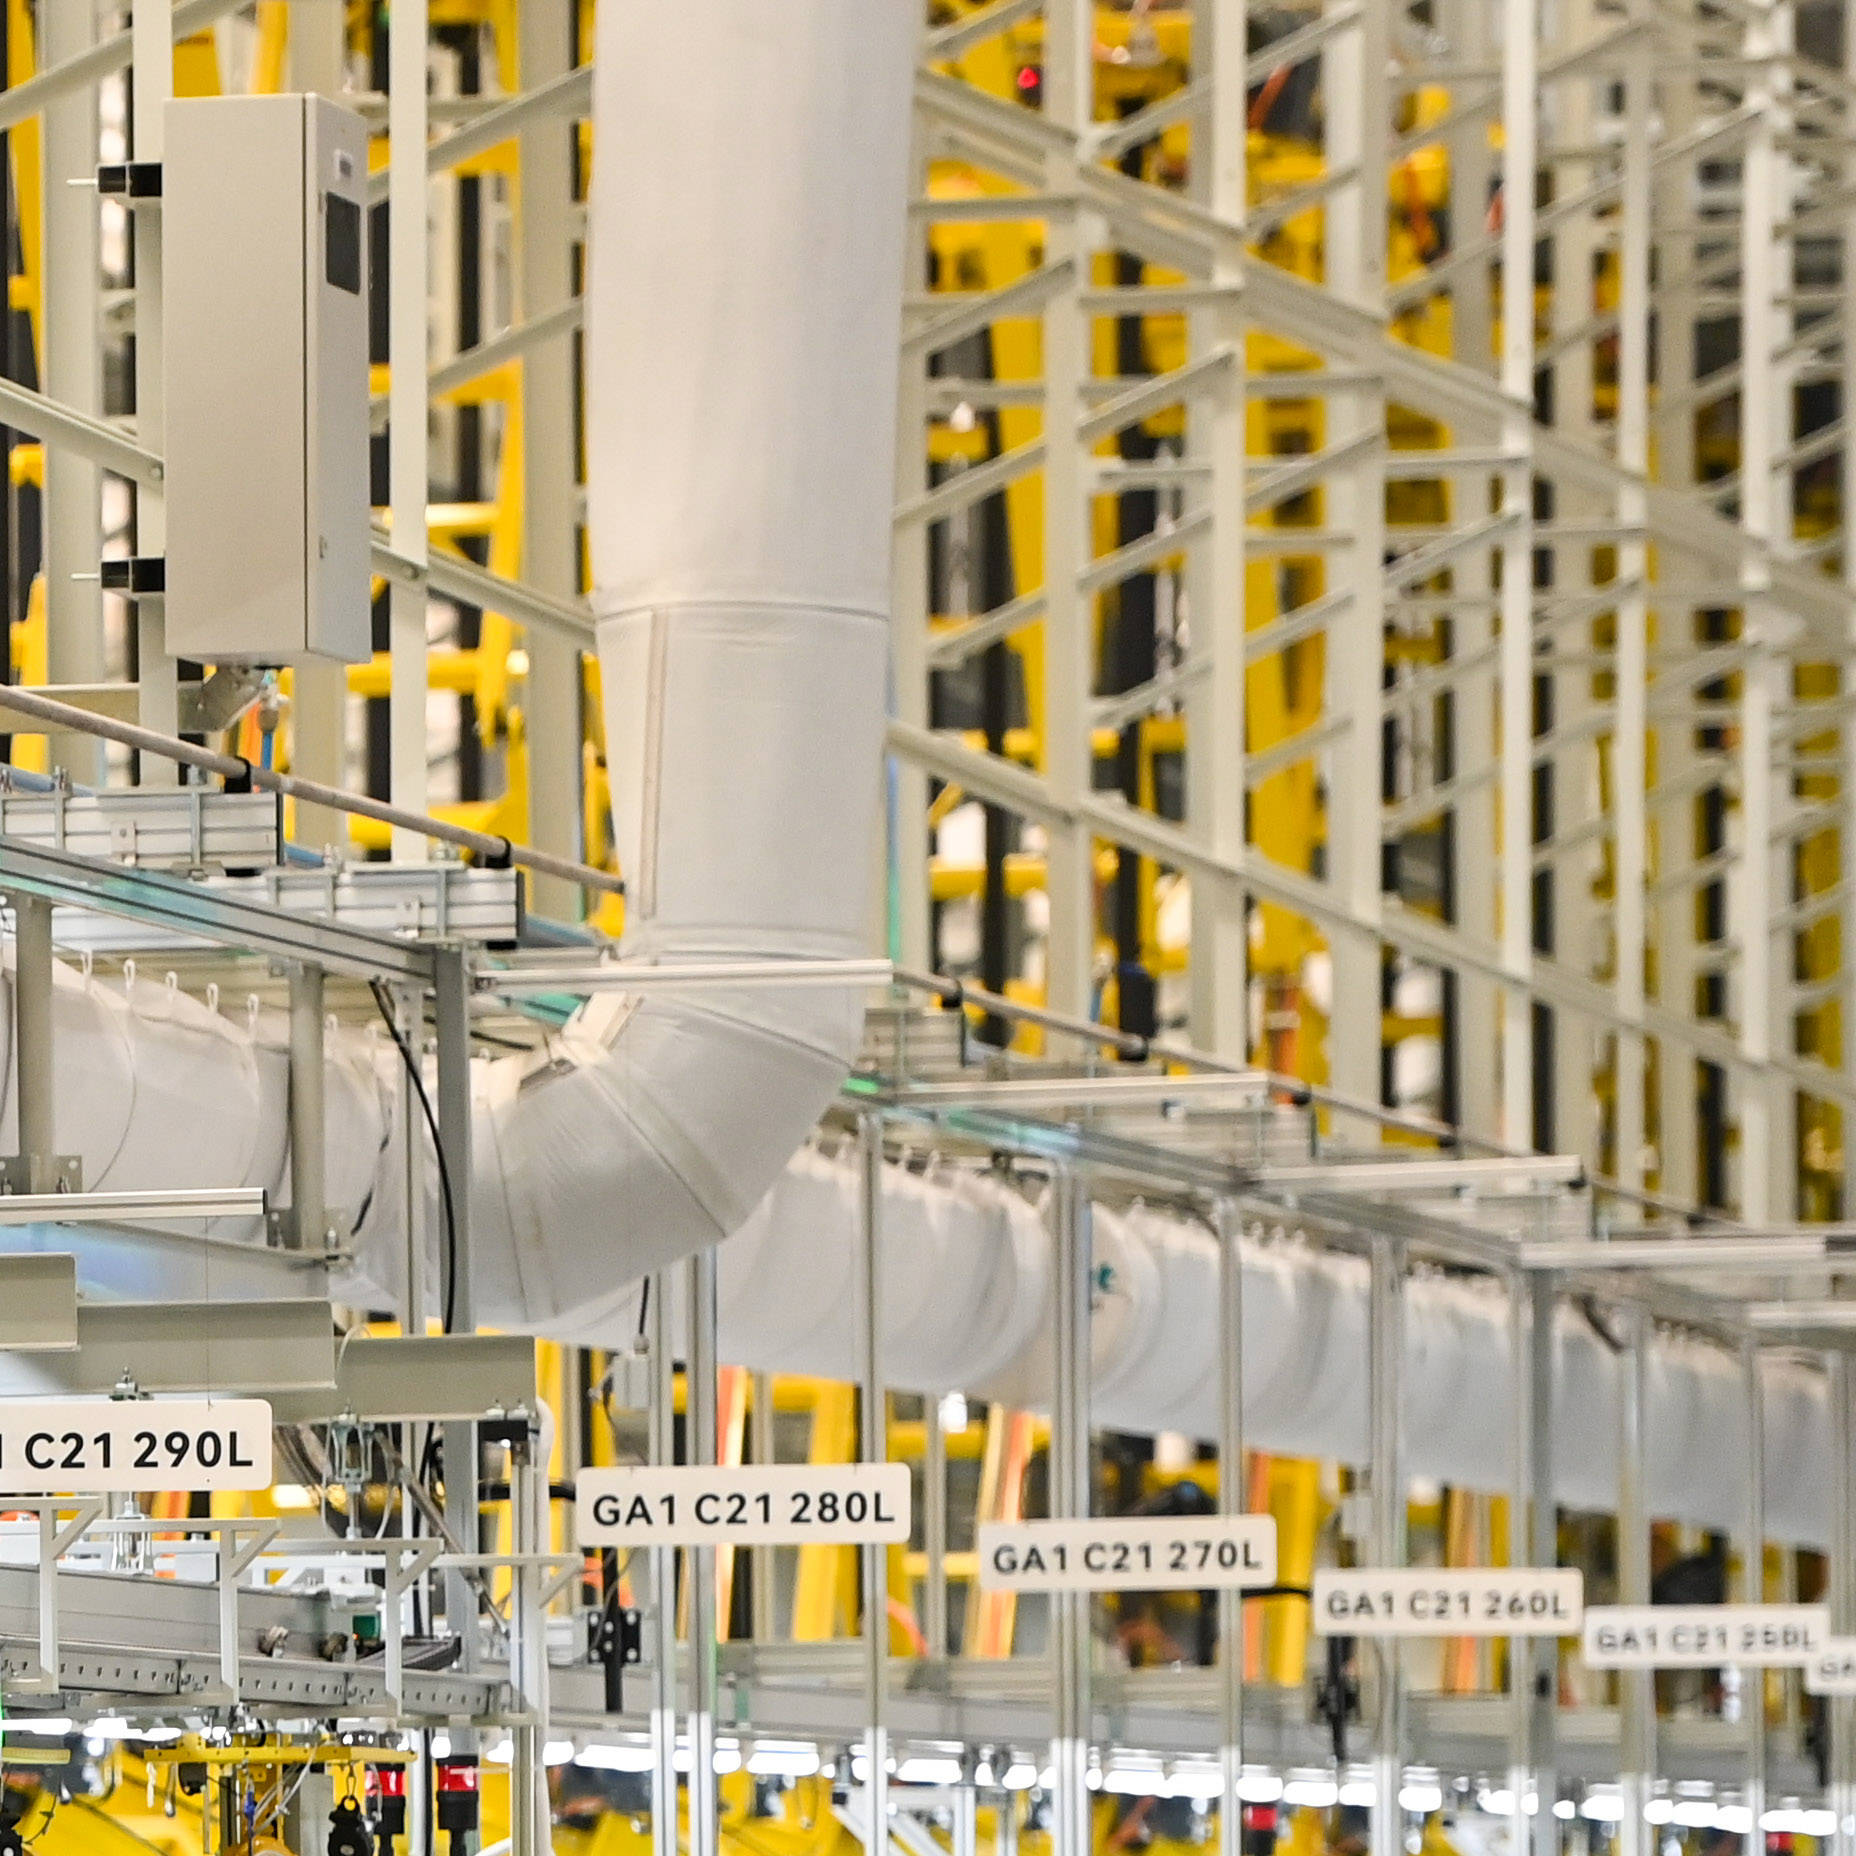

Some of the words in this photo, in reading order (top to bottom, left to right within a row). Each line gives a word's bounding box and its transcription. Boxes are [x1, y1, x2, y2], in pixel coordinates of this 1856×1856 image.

[24, 1432, 112, 1470] C21
[133, 1430, 253, 1468] 290L
[592, 1493, 675, 1527] GA1
[694, 1493, 771, 1525] C21
[789, 1491, 895, 1523] 280L
[993, 1543, 1067, 1573] GA1
[1084, 1542, 1152, 1572] C21
[1169, 1539, 1262, 1571] 270L
[1327, 1589, 1395, 1619] GA1
[1408, 1589, 1471, 1619] C21
[1485, 1588, 1569, 1619] 260L
